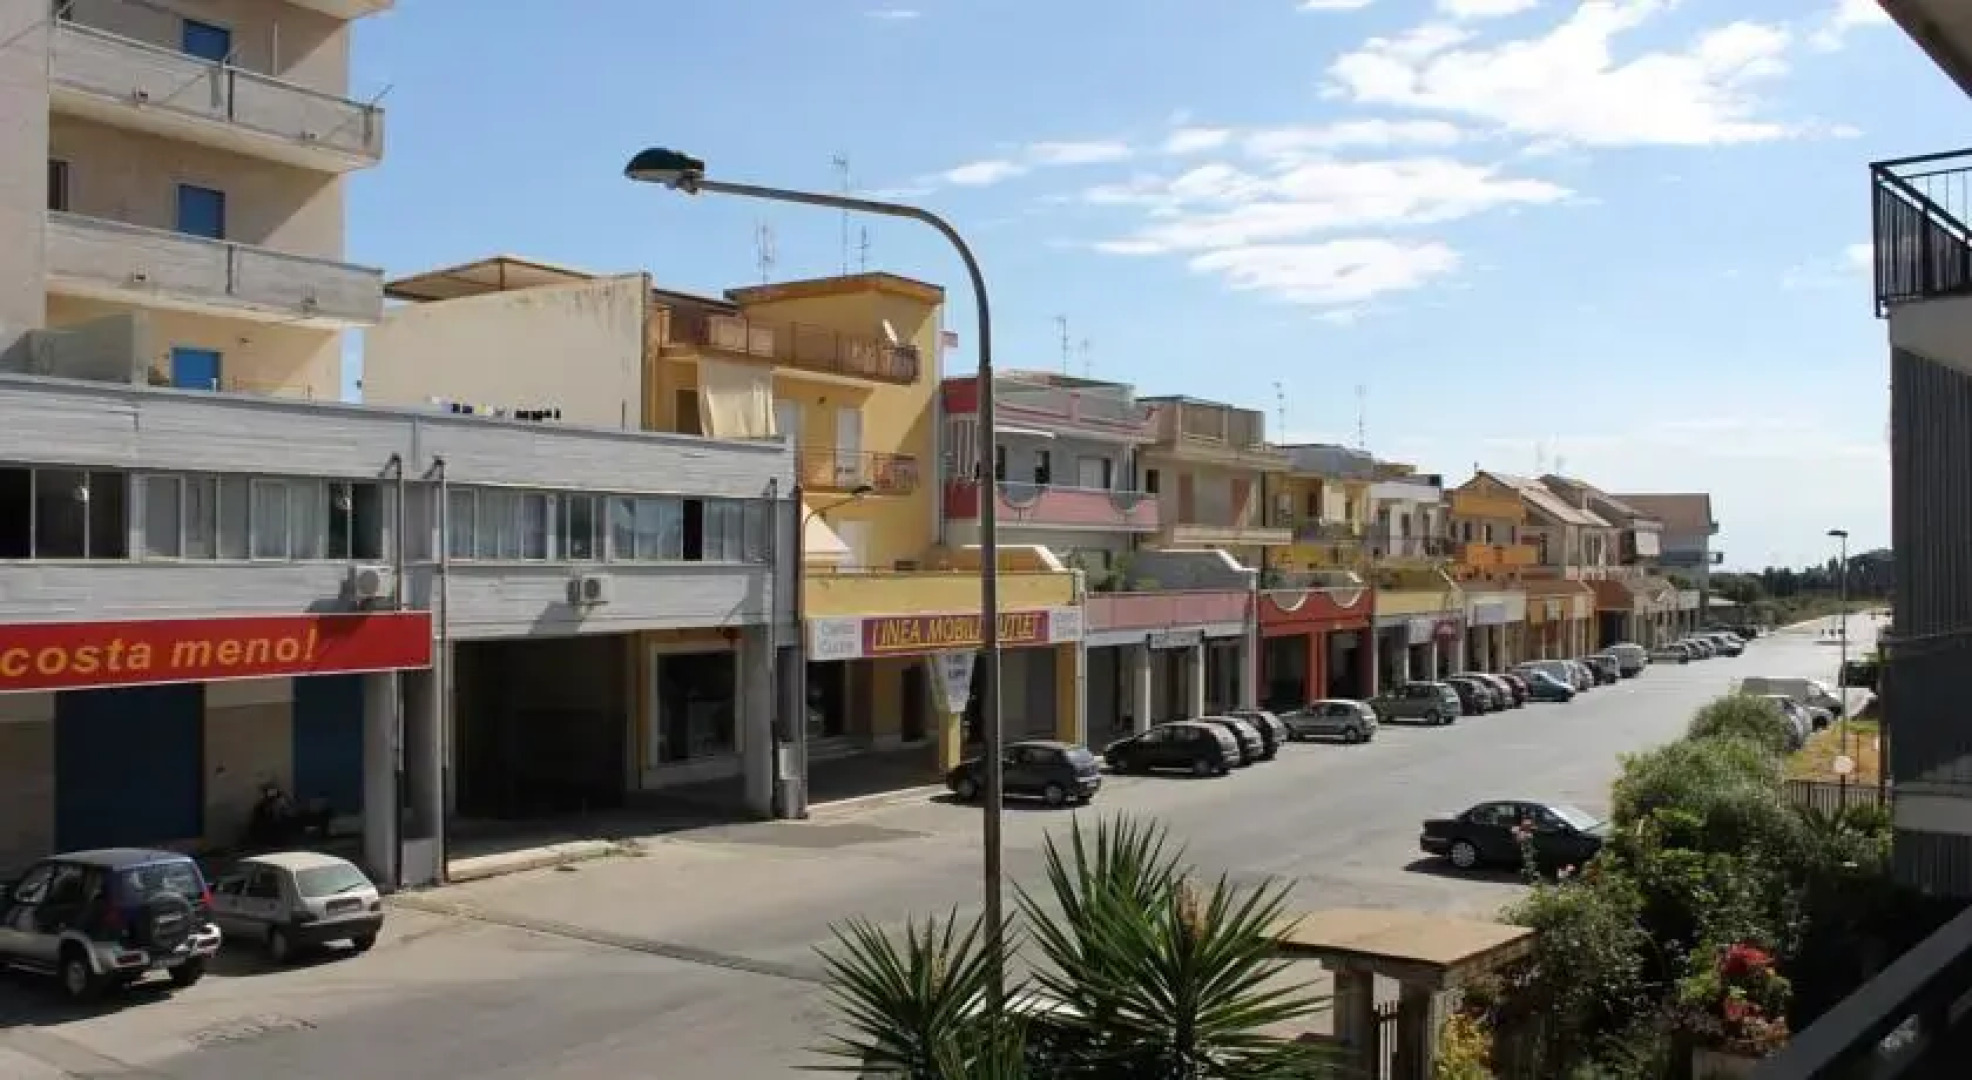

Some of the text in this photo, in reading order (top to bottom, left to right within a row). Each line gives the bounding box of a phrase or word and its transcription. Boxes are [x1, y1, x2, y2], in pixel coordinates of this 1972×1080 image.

[996, 612, 1042, 640] UTLET
[0, 619, 319, 677] costa meno!
